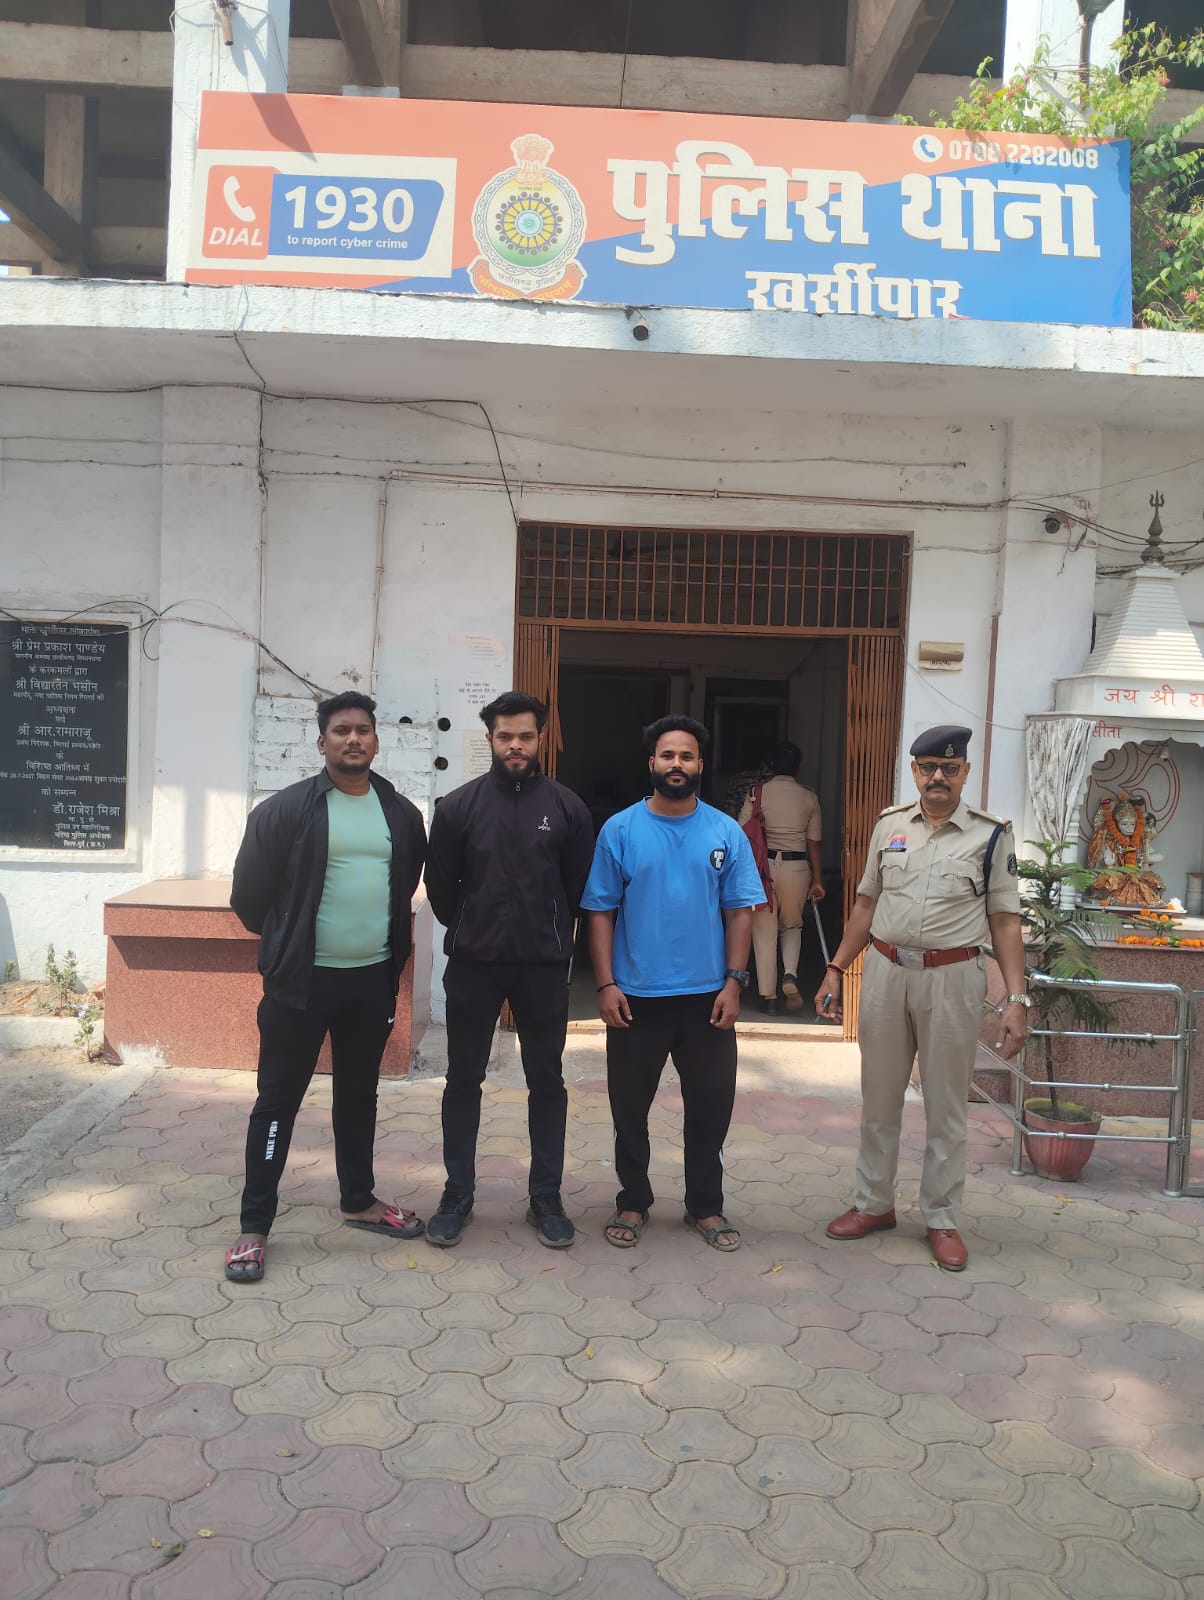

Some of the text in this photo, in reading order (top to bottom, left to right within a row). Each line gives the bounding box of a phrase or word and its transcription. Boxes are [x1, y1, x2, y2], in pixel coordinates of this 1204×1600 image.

[1006, 144, 1099, 169] 2282008
[285, 185, 415, 233] 1930
[607, 140, 1101, 265] पुलिस थाना
[208, 227, 263, 248] DIAL
[287, 235, 408, 249] to report cyber crime
[12, 638, 106, 653] श्री प्रेम प्रकाश पाण्डेय
[16, 677, 27, 689] श्री
[1104, 687, 1141, 704] जय
[1149, 684, 1177, 706] श्री
[18, 722, 30, 736] श्री
[97, 803, 121, 817] मिश्रा
[265, 1139, 275, 1160] NIKE
